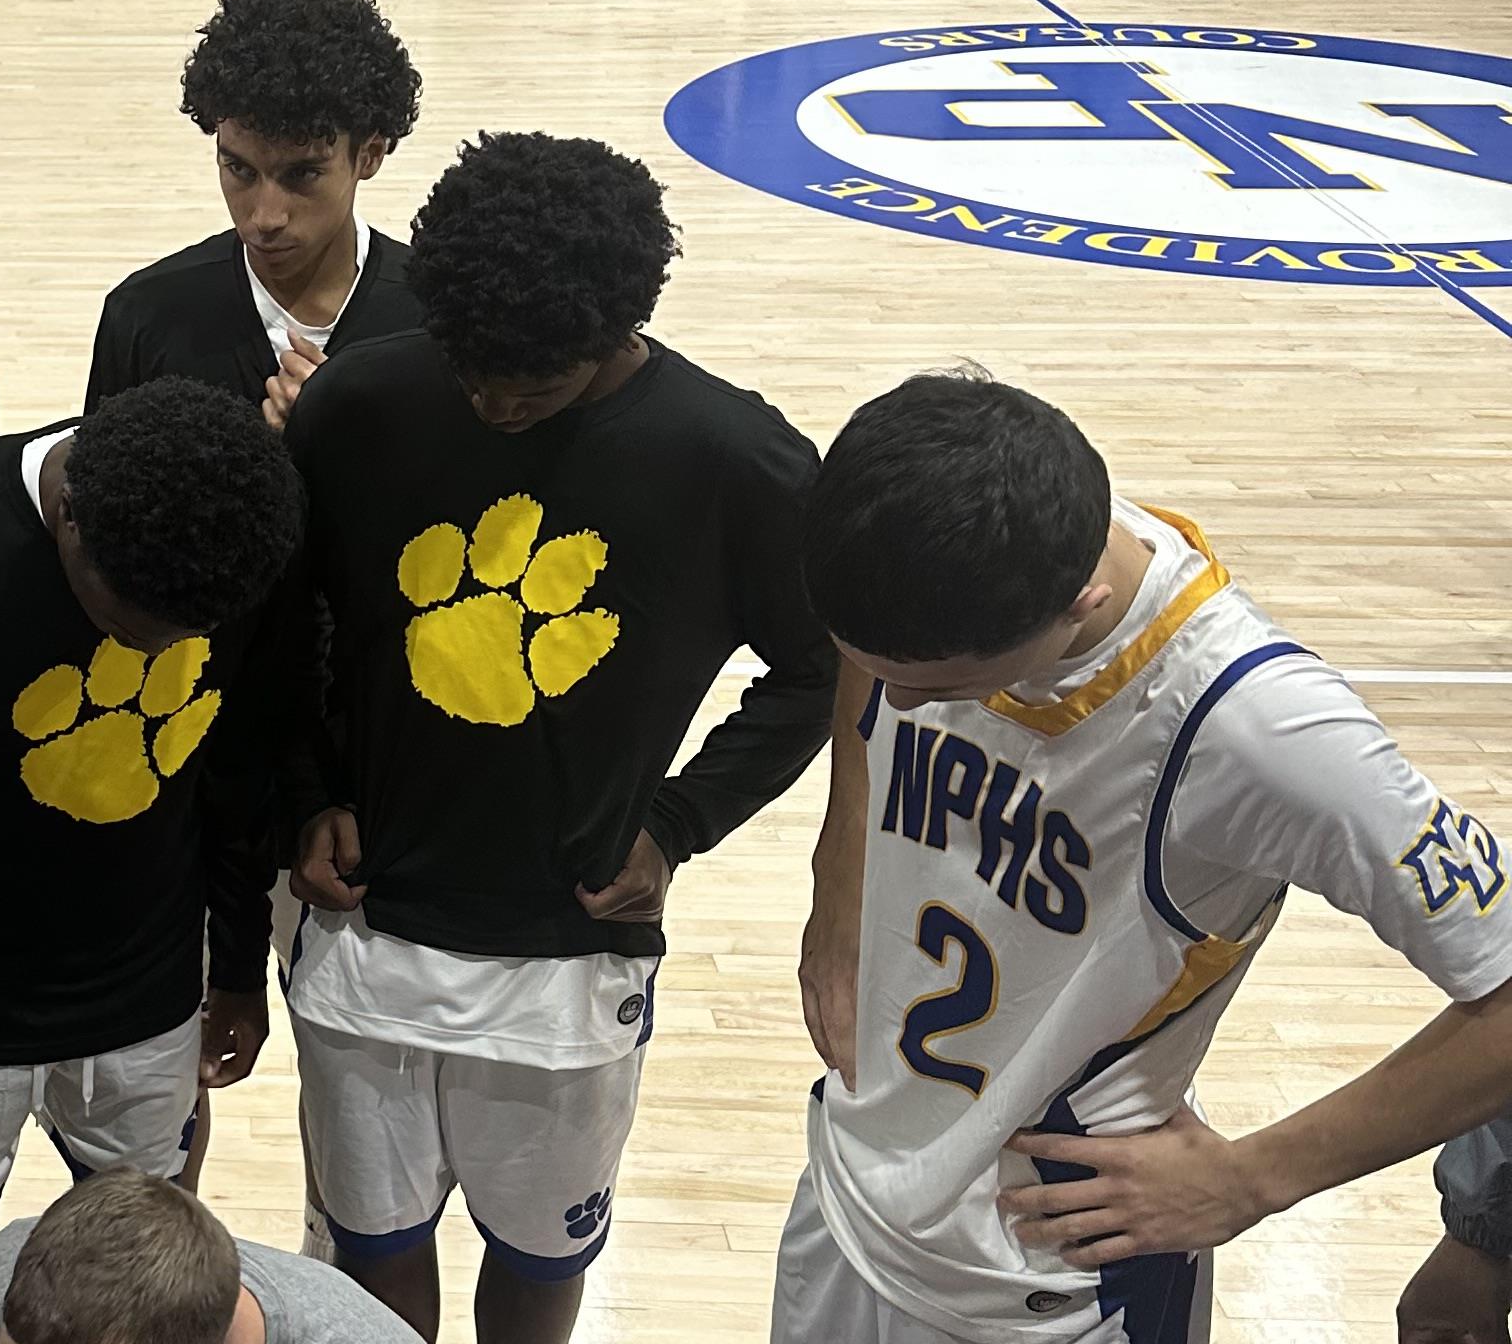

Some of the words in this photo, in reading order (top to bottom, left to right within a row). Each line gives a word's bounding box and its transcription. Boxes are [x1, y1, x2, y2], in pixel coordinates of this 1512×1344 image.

[878, 25, 1319, 53] COUGARS
[804, 177, 1512, 274] ROVIDENCE
[881, 718, 1094, 936] NPHS
[897, 899, 1000, 1101] 2
